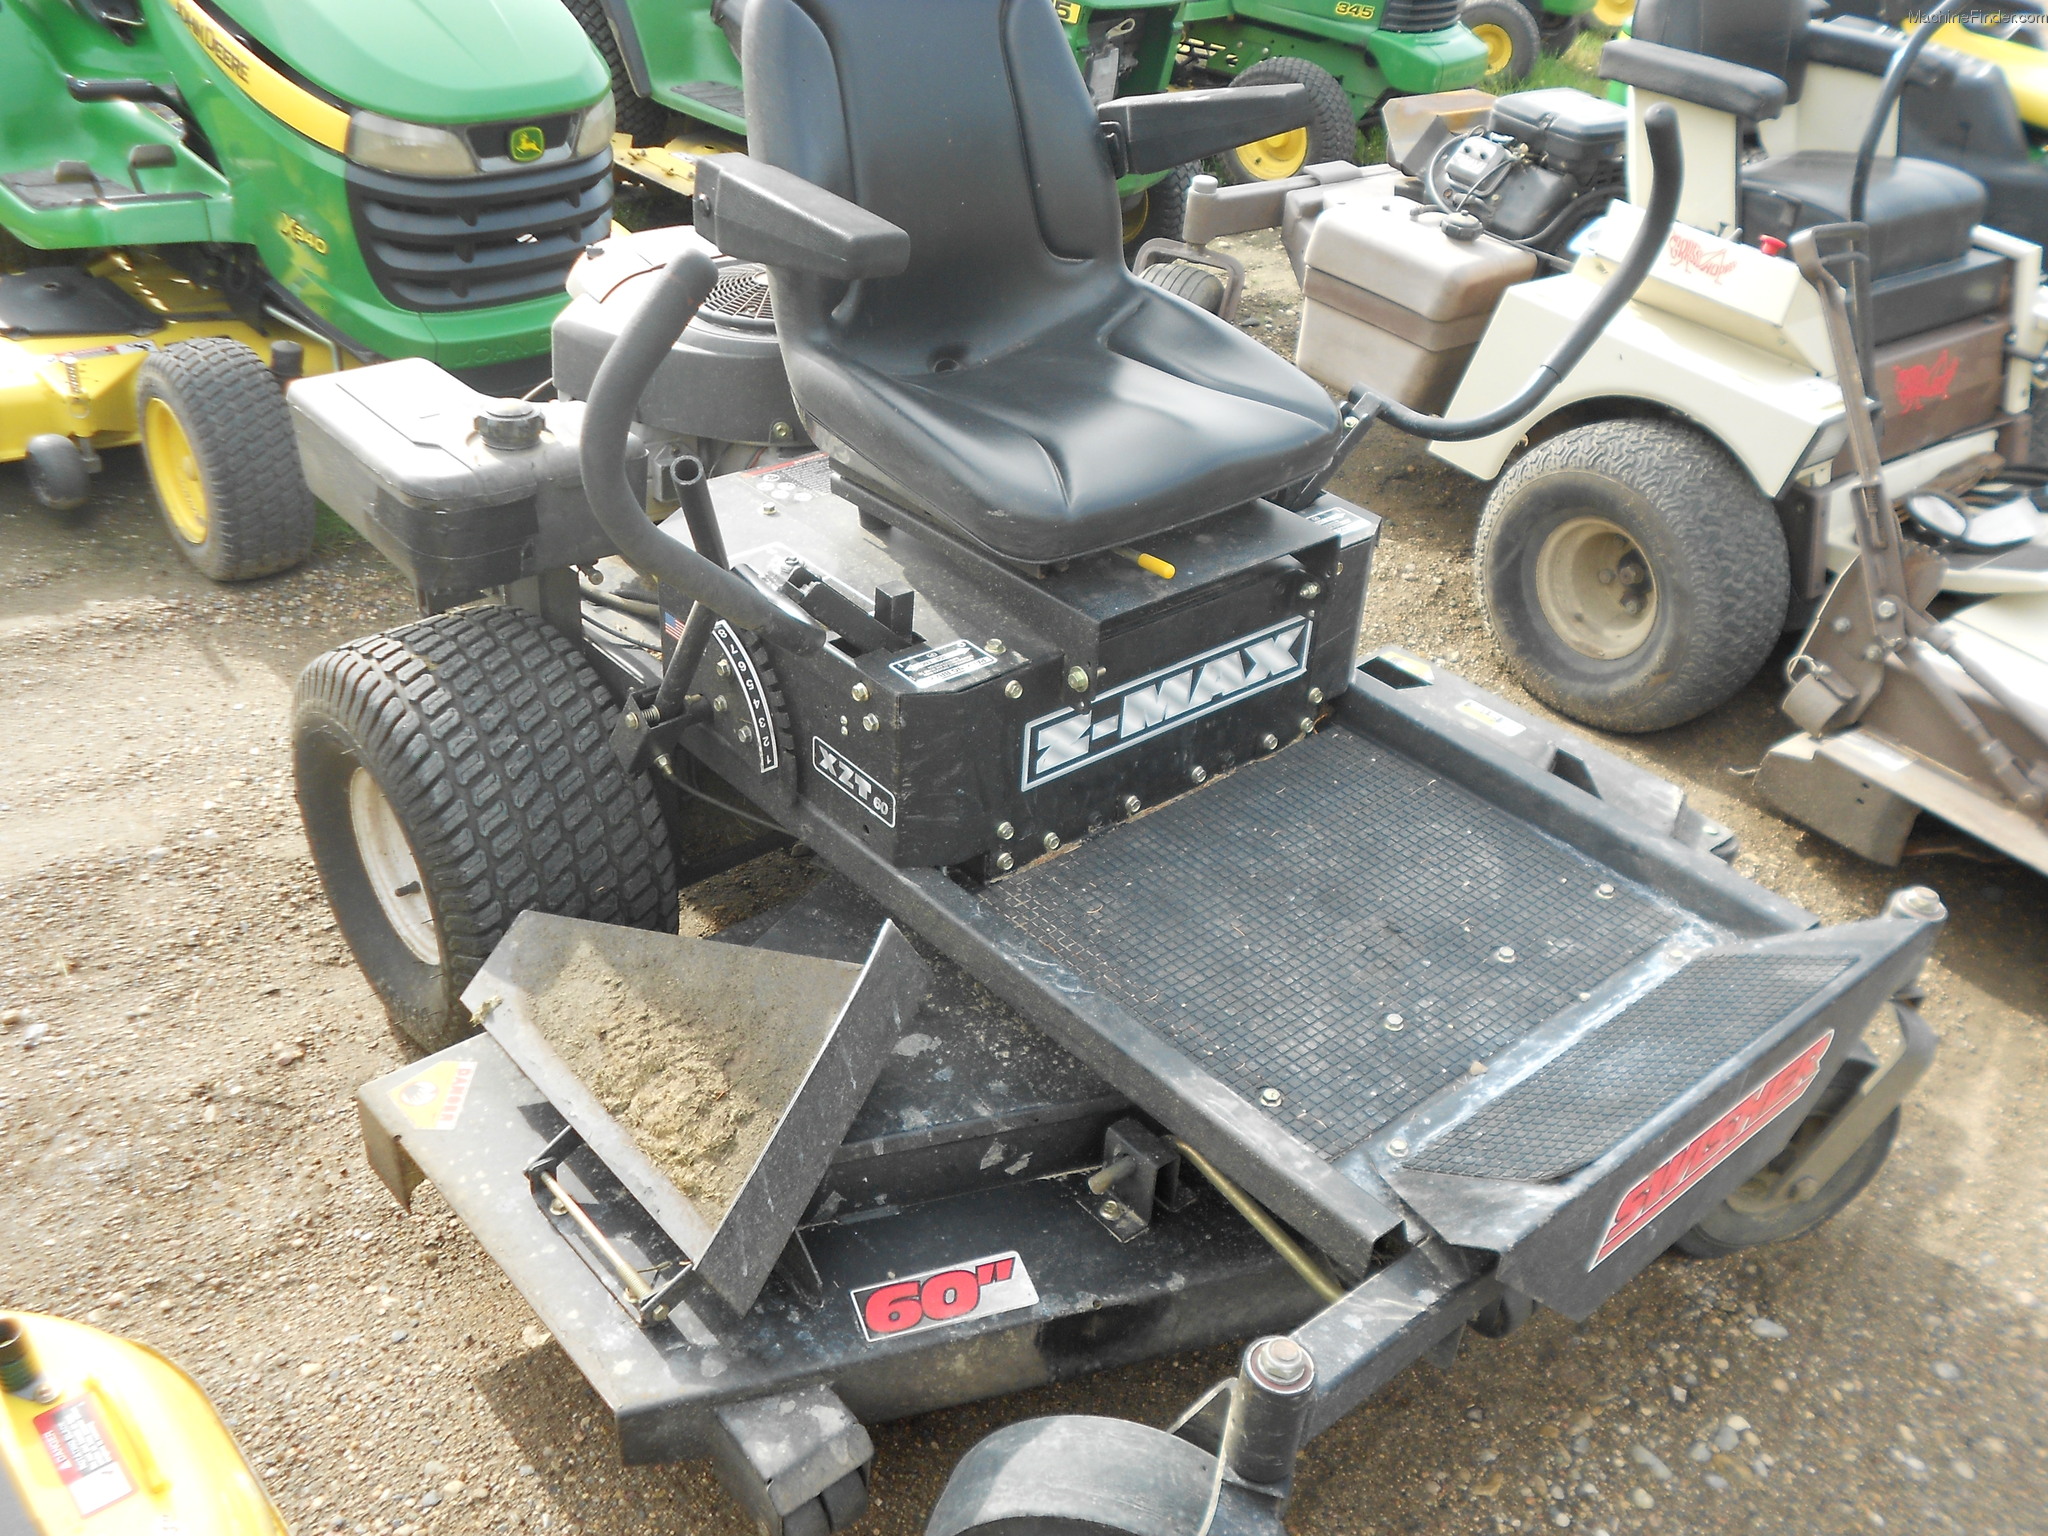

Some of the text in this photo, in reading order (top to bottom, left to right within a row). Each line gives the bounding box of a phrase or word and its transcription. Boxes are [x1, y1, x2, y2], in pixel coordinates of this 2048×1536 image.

[1335, 1, 1375, 19] 345
[205, 27, 250, 85] DEERE
[717, 628, 728, 639] 8
[730, 643, 739, 655] 7
[737, 660, 747, 672] 6
[745, 678, 755, 691] 5
[752, 697, 761, 710] 4
[1035, 624, 1305, 774] Z-MAX
[758, 717, 766, 729] 3
[762, 735, 770, 747] 2
[765, 755, 772, 765] 1
[819, 745, 889, 816] XZT 60
[864, 1256, 1016, 1334] 60"
[43, 1429, 67, 1464] DANGER
